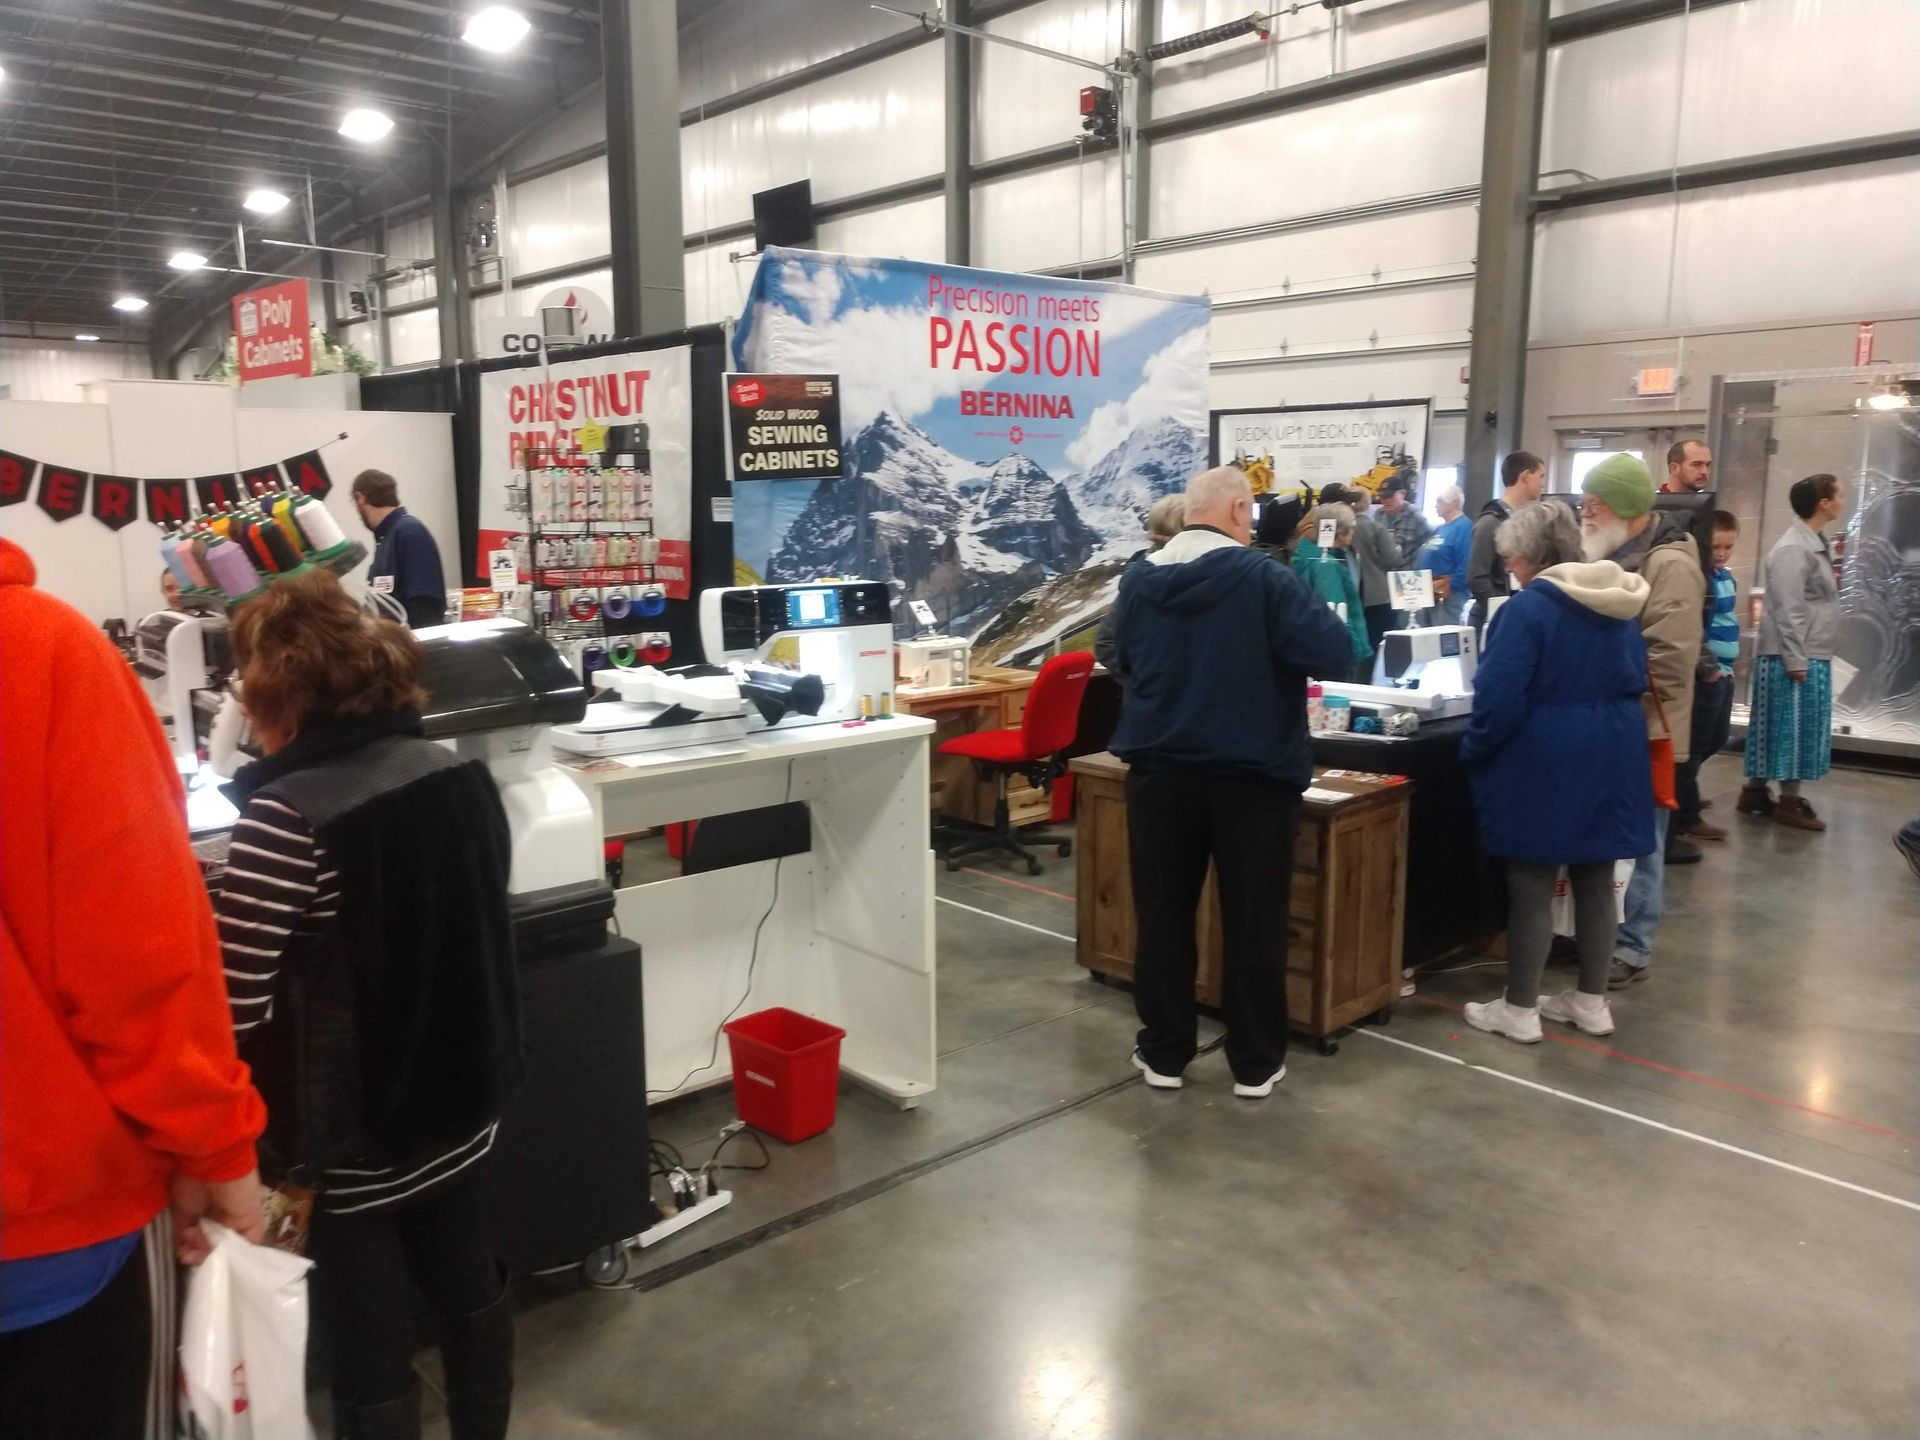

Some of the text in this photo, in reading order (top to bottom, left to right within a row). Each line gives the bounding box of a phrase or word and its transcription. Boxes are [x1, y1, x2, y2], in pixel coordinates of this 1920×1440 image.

[261, 293, 292, 329] Poly
[928, 275, 1100, 323] Precision meets
[243, 334, 304, 368] Cabinets
[929, 316, 1100, 377] PASSION
[509, 370, 650, 424] CHESTNUT
[960, 390, 1075, 419] BERNINA
[748, 424, 829, 446] SEWING
[1235, 427, 1272, 442] DECK
[1308, 424, 1347, 440] DECK
[1352, 421, 1397, 438] DOWN
[740, 448, 840, 472] CABINETS
